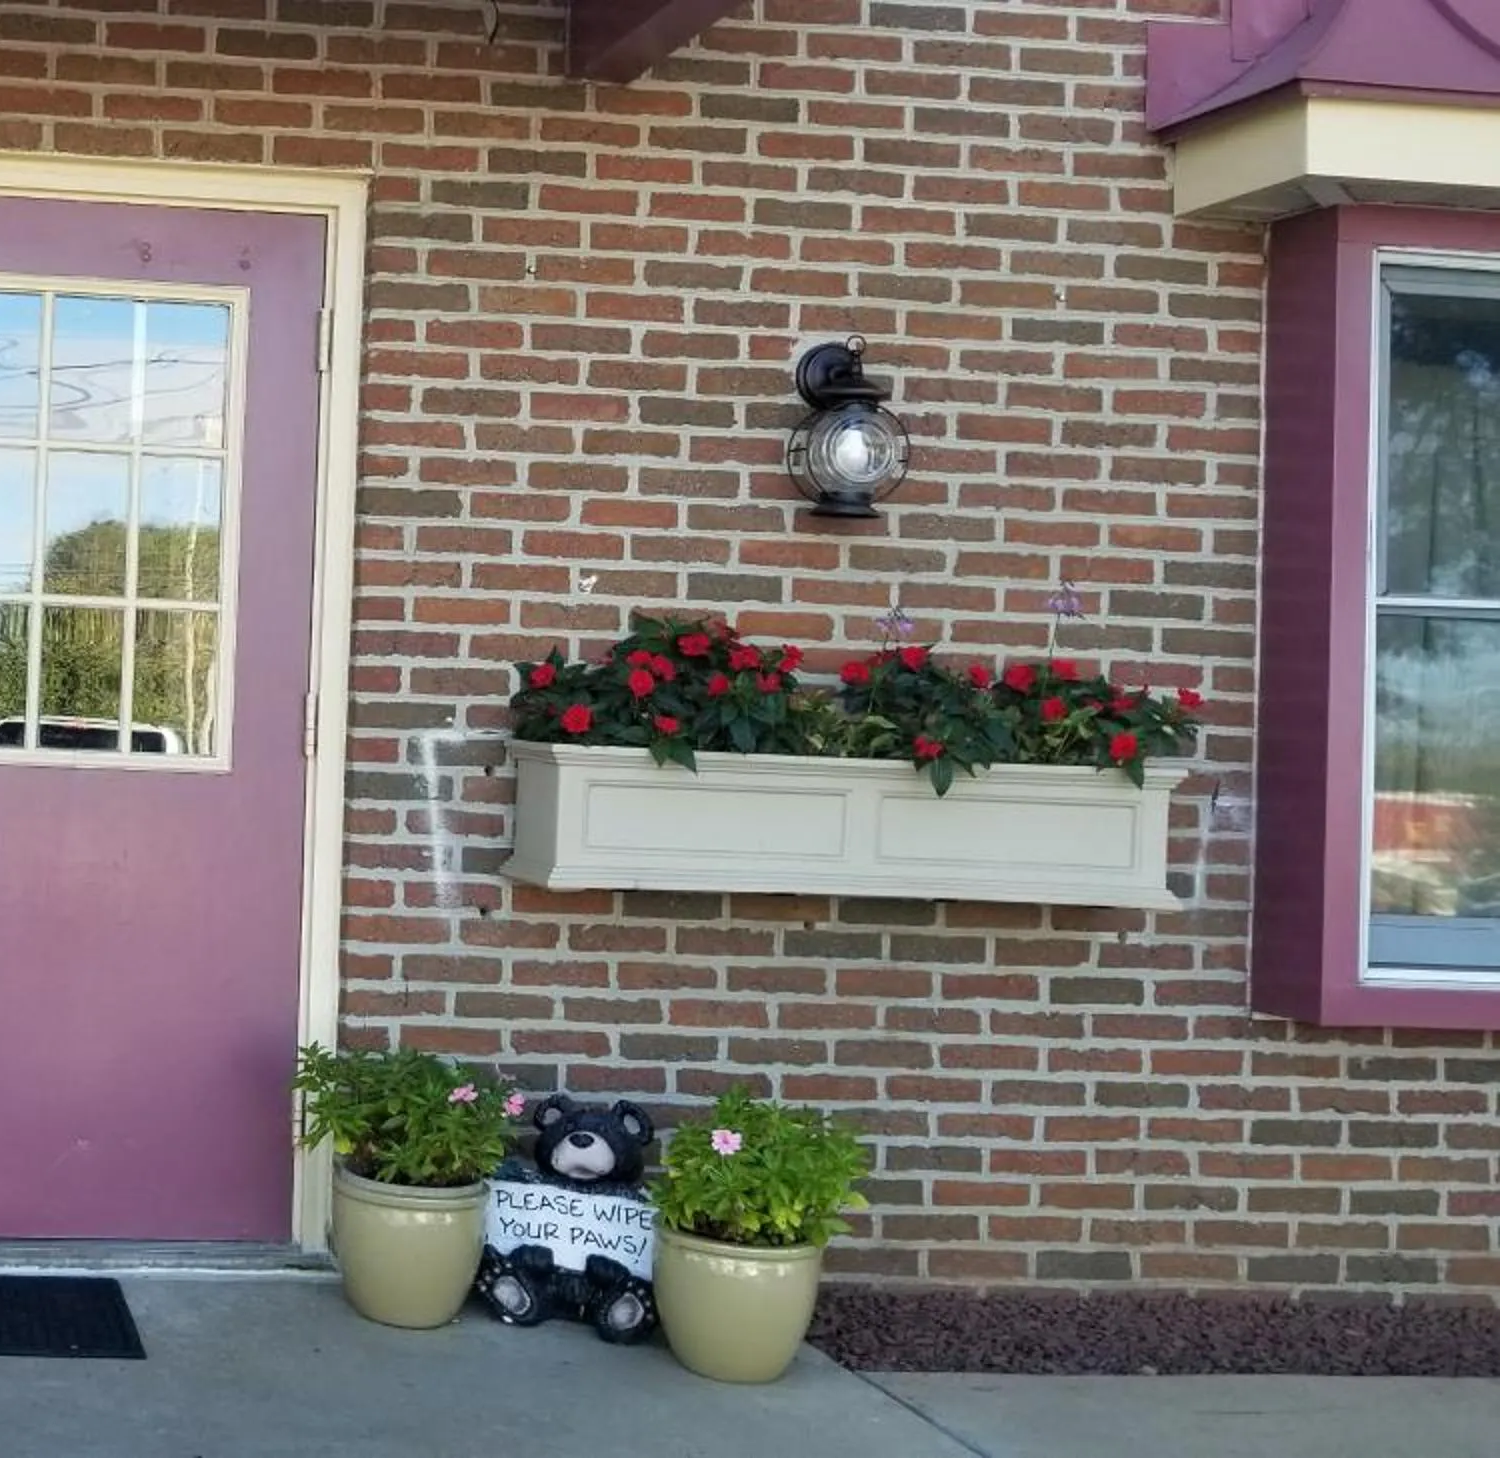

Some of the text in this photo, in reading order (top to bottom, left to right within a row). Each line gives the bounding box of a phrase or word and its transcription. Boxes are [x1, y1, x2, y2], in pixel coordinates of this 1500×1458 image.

[495, 1189, 653, 1231] PLEASE WIPE
[499, 1216, 647, 1264] YOUR PAWS!
